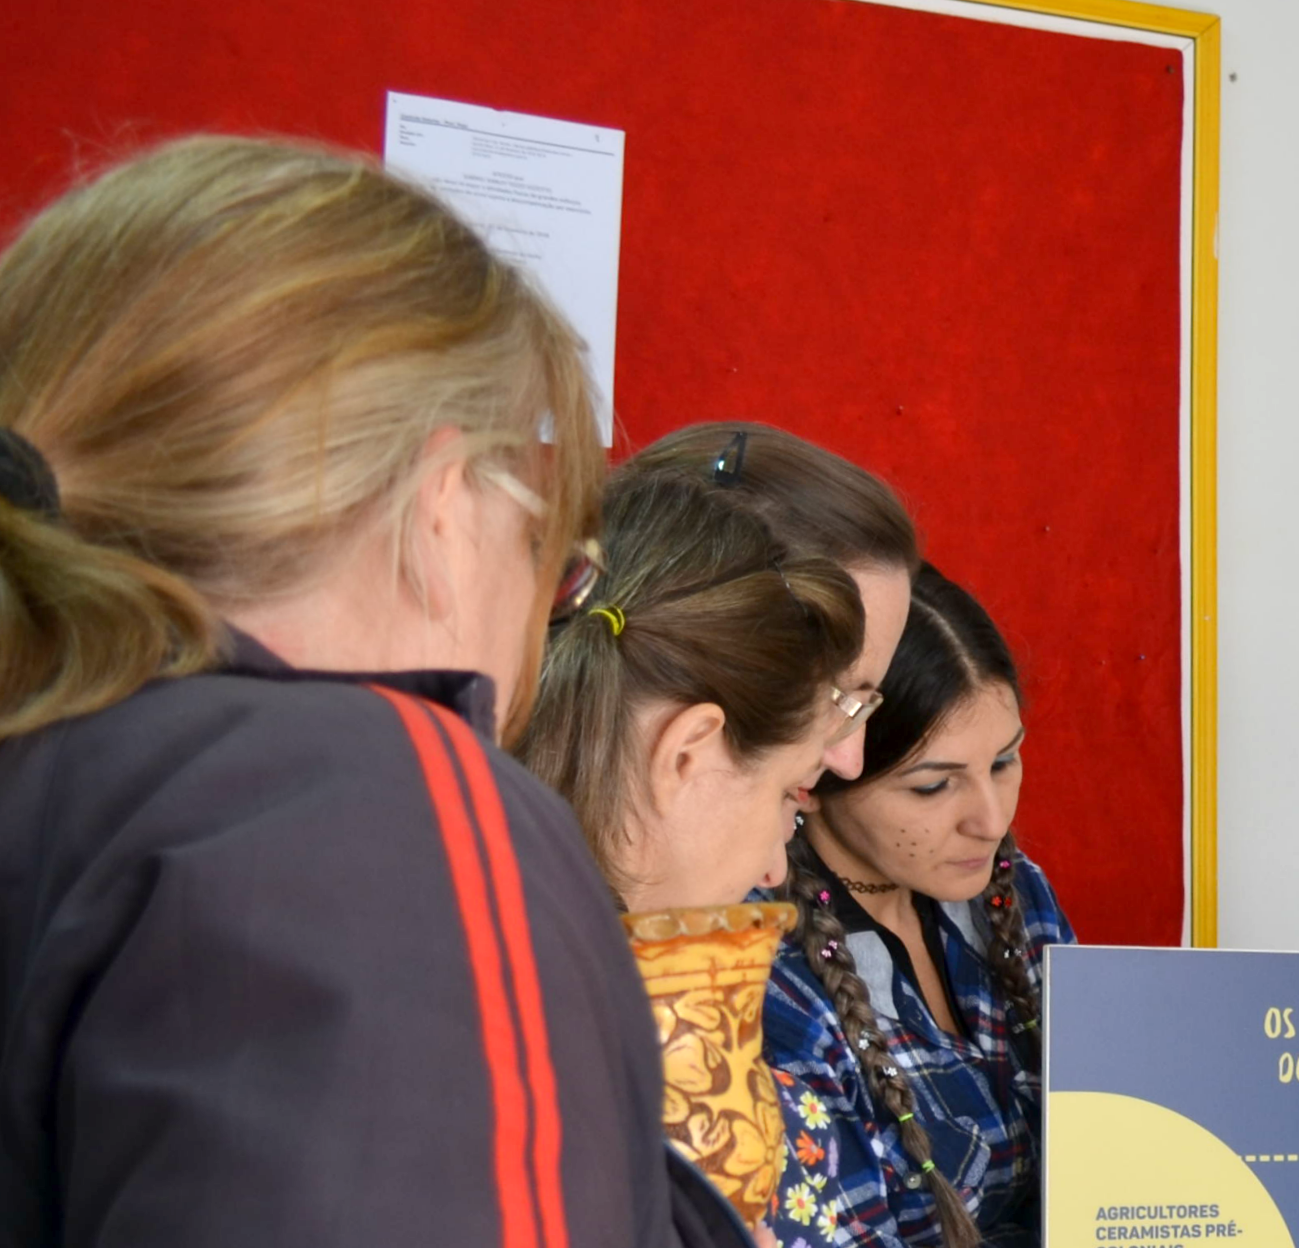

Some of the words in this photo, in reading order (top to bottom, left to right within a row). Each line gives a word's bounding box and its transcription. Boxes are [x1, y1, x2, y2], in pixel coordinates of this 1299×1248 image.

[1264, 1007, 1296, 1039] OS
[1096, 1204, 1220, 1221] AGRICULTORES
[1096, 1224, 1202, 1241] CERAMISTAS
[1205, 1220, 1243, 1238] PRÉ-
